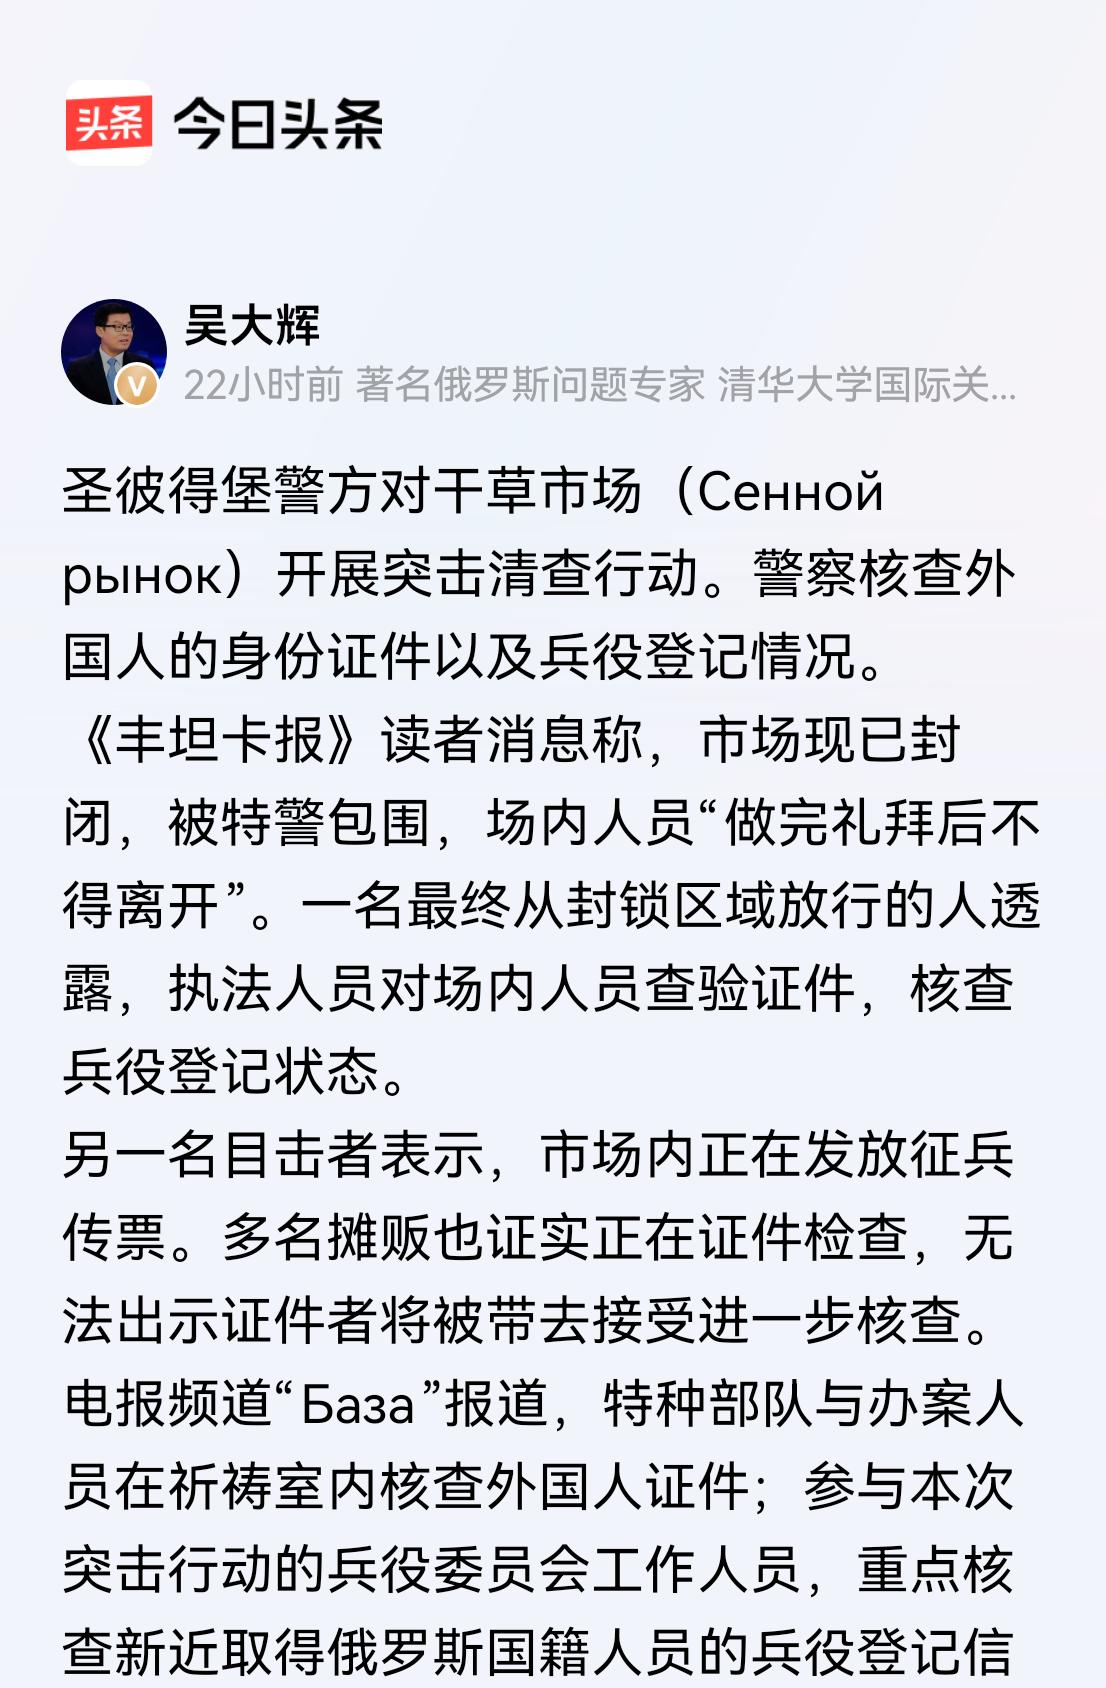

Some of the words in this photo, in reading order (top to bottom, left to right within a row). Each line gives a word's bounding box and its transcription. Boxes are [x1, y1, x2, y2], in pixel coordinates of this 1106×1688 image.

[76, 104, 142, 142] 头条
[174, 96, 383, 150] 今日头条
[184, 302, 320, 347] 吴大辉
[127, 375, 148, 398] V
[184, 364, 344, 404] 22小时前
[355, 364, 706, 404] 著名俄罗斯问题专家
[66, 631, 877, 682] 国人的身份证件以及兵役登记情况。
[88, 714, 960, 767] 《丰坦卡报》读者消息称，市场现已封
[64, 963, 1013, 1016] 露，执法人员对场内人员查验证件，核查
[64, 1046, 399, 1097] 兵役登记状态。
[64, 1129, 1013, 1182] 另一名目击者表示，市场内正在发放征兵
[63, 1212, 1012, 1265] 传票。多名摊贩也证实正在证件检查，无
[63, 1295, 982, 1346] 法出示证件者将被带去接受进一步核查。
[64, 1461, 1013, 1514] 员在祈祷室内核查外国人证件；参与本次
[64, 1544, 1012, 1597] 突击行动的兵役委员会工作人员，重点核
[63, 1627, 1013, 1677] 查新近取得俄罗斯国籍人员的兵役登记信
